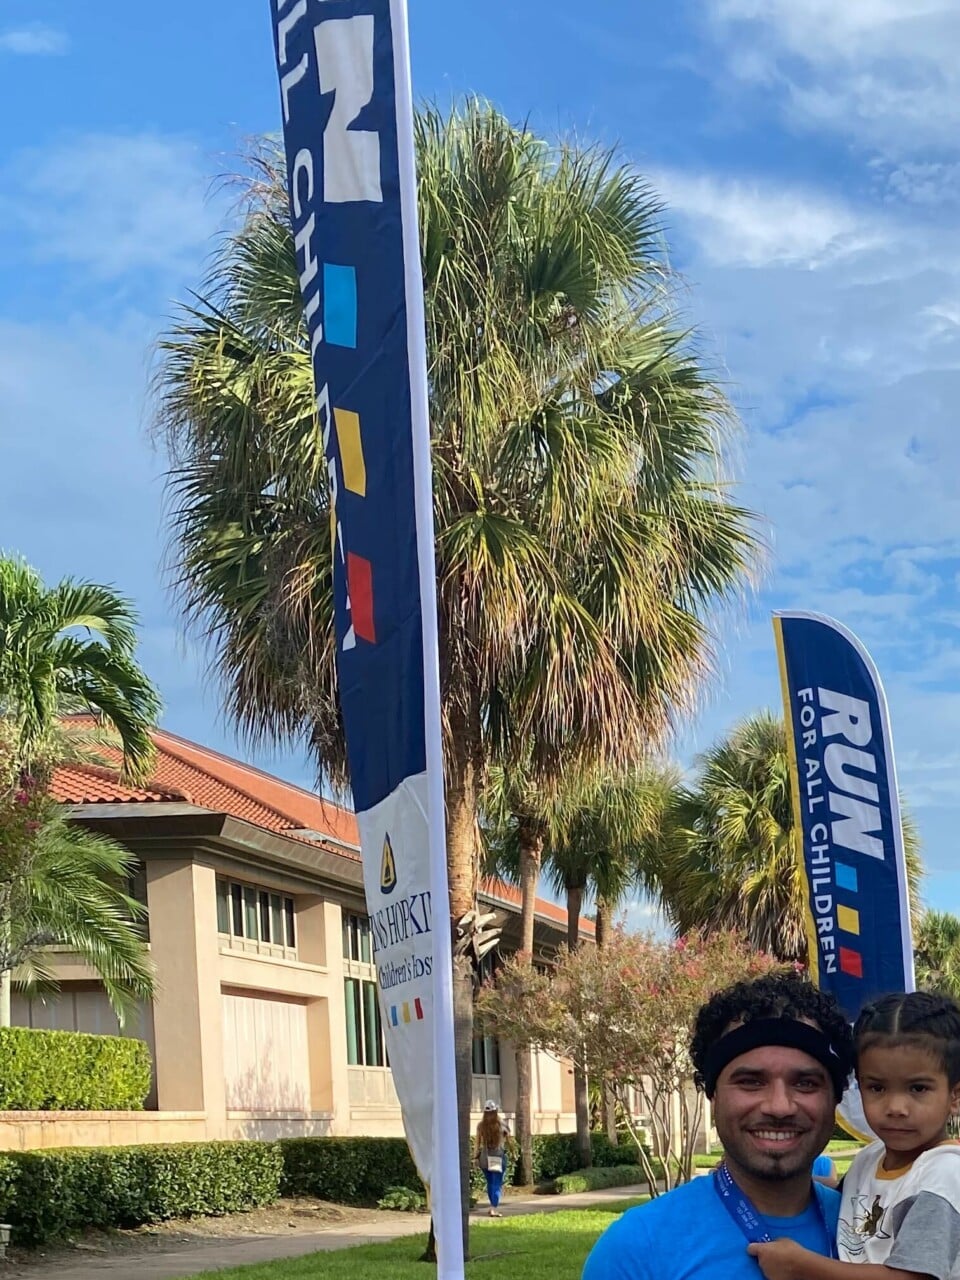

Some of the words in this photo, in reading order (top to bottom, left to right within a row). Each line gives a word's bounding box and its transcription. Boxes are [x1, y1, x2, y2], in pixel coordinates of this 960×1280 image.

[277, 0, 309, 125] LL
[797, 687, 817, 750] FOR
[817, 686, 885, 861] RUN
[804, 758, 825, 814] ALL
[810, 823, 837, 974] CHILDREN
